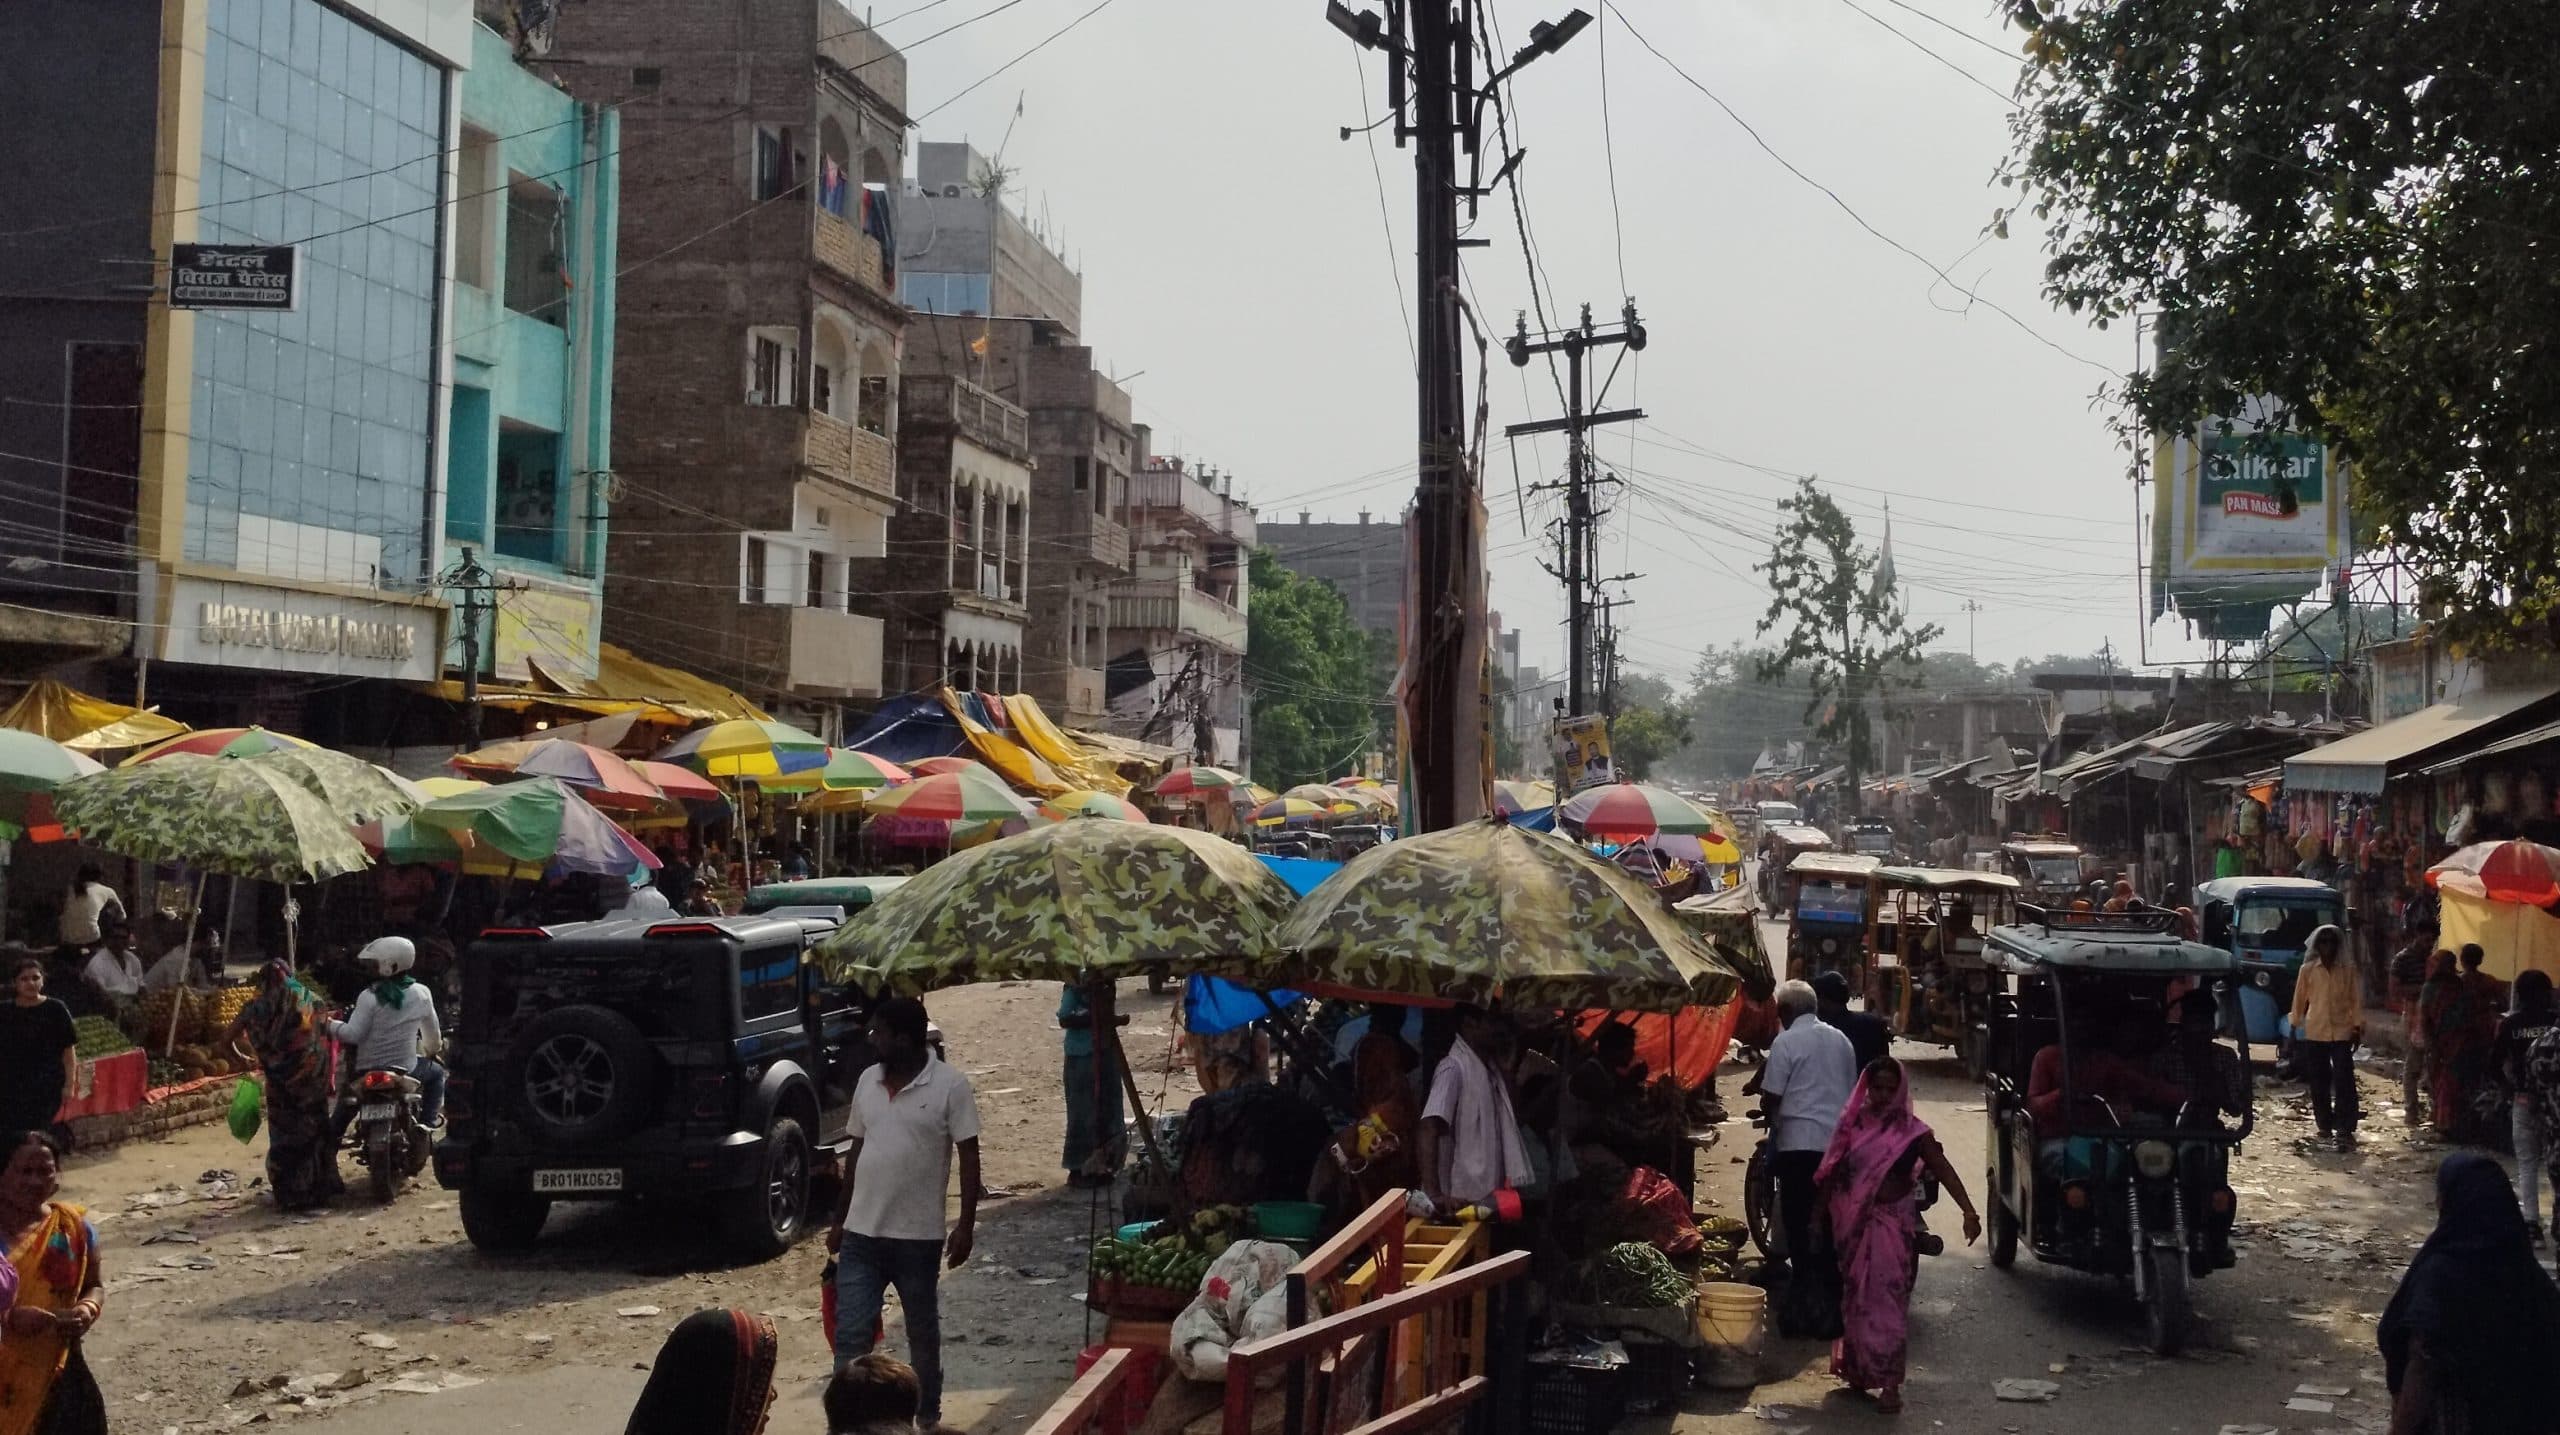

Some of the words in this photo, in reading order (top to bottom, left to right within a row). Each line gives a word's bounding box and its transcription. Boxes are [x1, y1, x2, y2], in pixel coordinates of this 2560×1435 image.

[198, 250, 268, 268] होटल
[177, 268, 232, 285] विराज
[237, 269, 287, 287] पैलेस
[2227, 496, 2249, 512] PAN
[202, 603, 271, 646] HOTEL
[344, 619, 415, 659] PALACE
